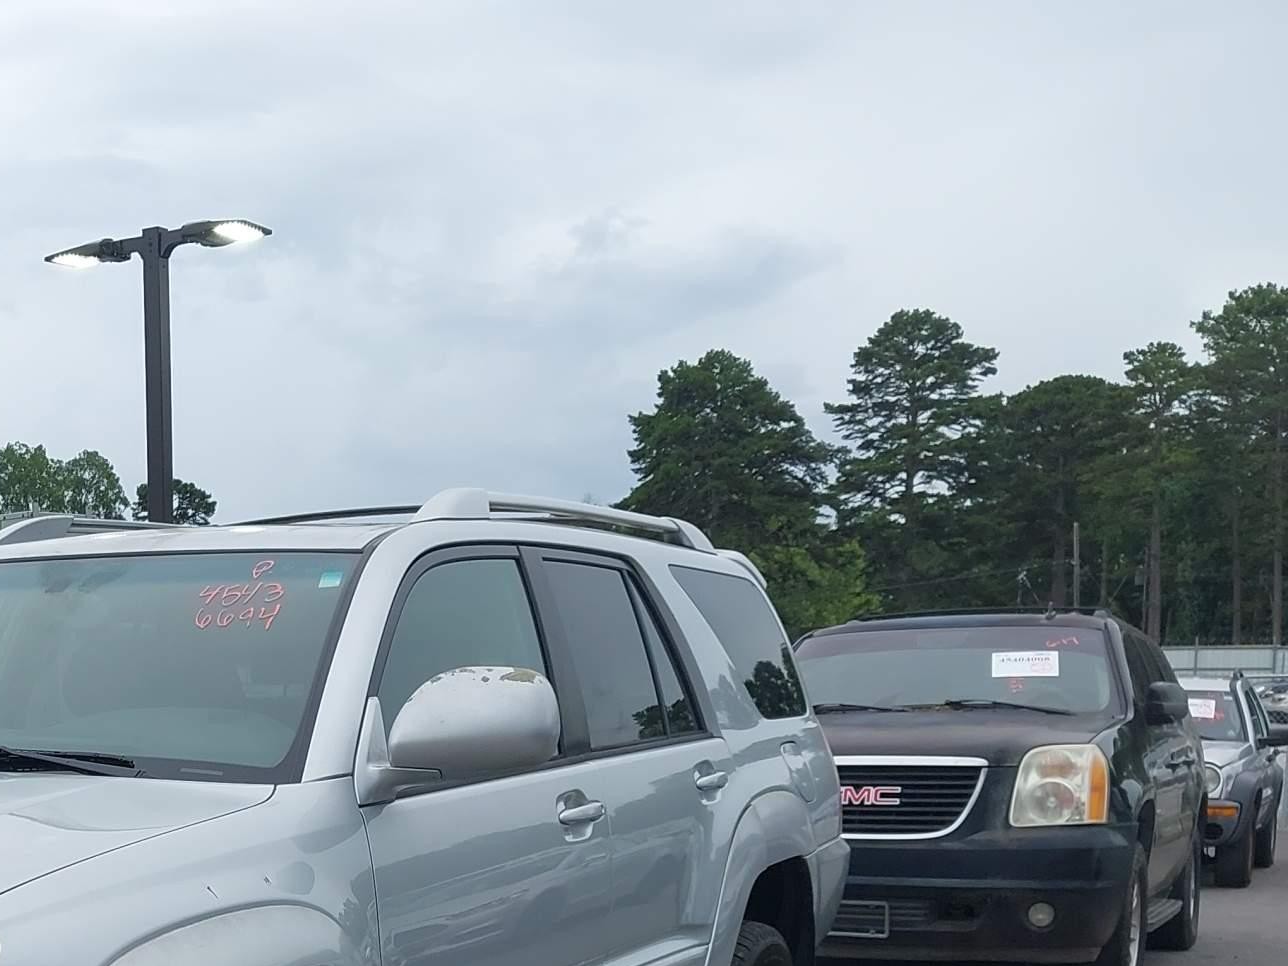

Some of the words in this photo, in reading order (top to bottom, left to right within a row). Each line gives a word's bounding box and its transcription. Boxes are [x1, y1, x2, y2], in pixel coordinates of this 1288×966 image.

[199, 583, 285, 606] 4543
[195, 604, 281, 631] 6694
[840, 786, 902, 805] MC
